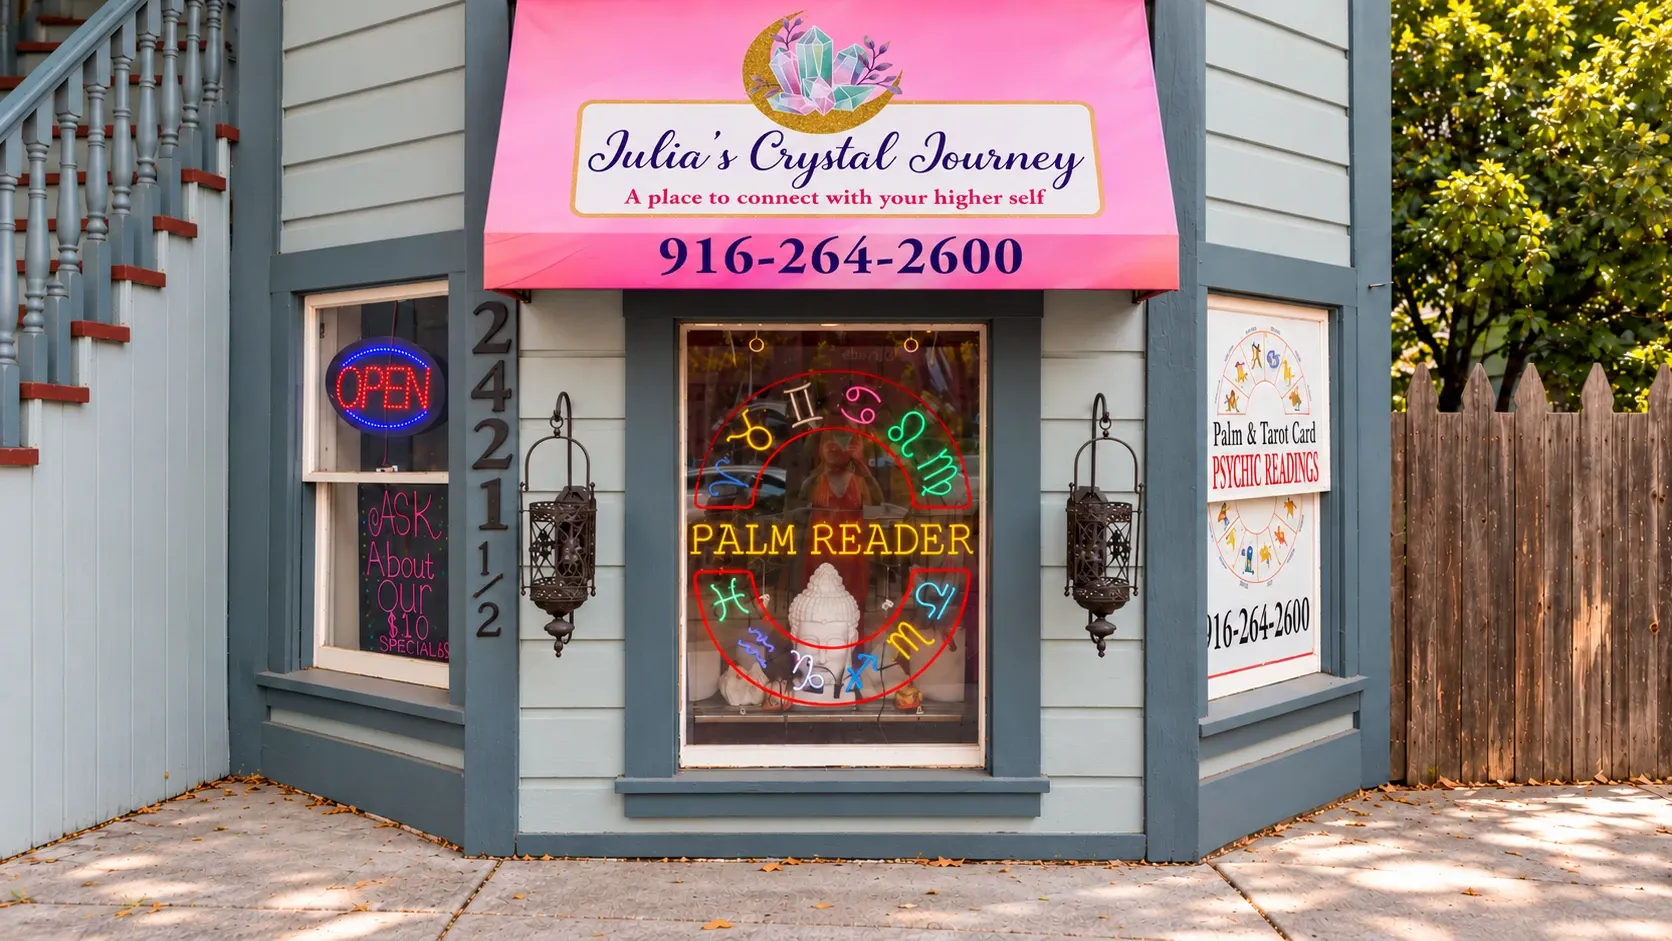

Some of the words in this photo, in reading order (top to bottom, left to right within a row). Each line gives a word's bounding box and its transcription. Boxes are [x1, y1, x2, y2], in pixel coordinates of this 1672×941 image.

[588, 129, 738, 173] Julia's
[750, 130, 900, 190] Crystal
[909, 131, 1085, 190] Journey
[624, 188, 641, 205] A
[648, 188, 703, 209] place
[709, 192, 730, 205] to
[737, 192, 819, 206] connect
[826, 189, 873, 206] with
[879, 192, 928, 209] your
[934, 189, 1003, 210] higher
[1008, 188, 1047, 206] self
[659, 235, 1023, 276] 916-264-2600
[336, 365, 433, 410] OPEN
[1213, 420, 1243, 447] Palm
[1247, 421, 1257, 445] &
[1260, 421, 1289, 445] Tarot
[1292, 420, 1317, 444] Card
[1212, 453, 1261, 490] PSYCHIC
[1265, 451, 1319, 486] READINGS
[367, 490, 443, 541] ASK
[690, 523, 797, 555] PALM
[810, 523, 974, 555] READER
[366, 541, 435, 580] About
[377, 579, 433, 615] Our
[387, 610, 429, 641] $10
